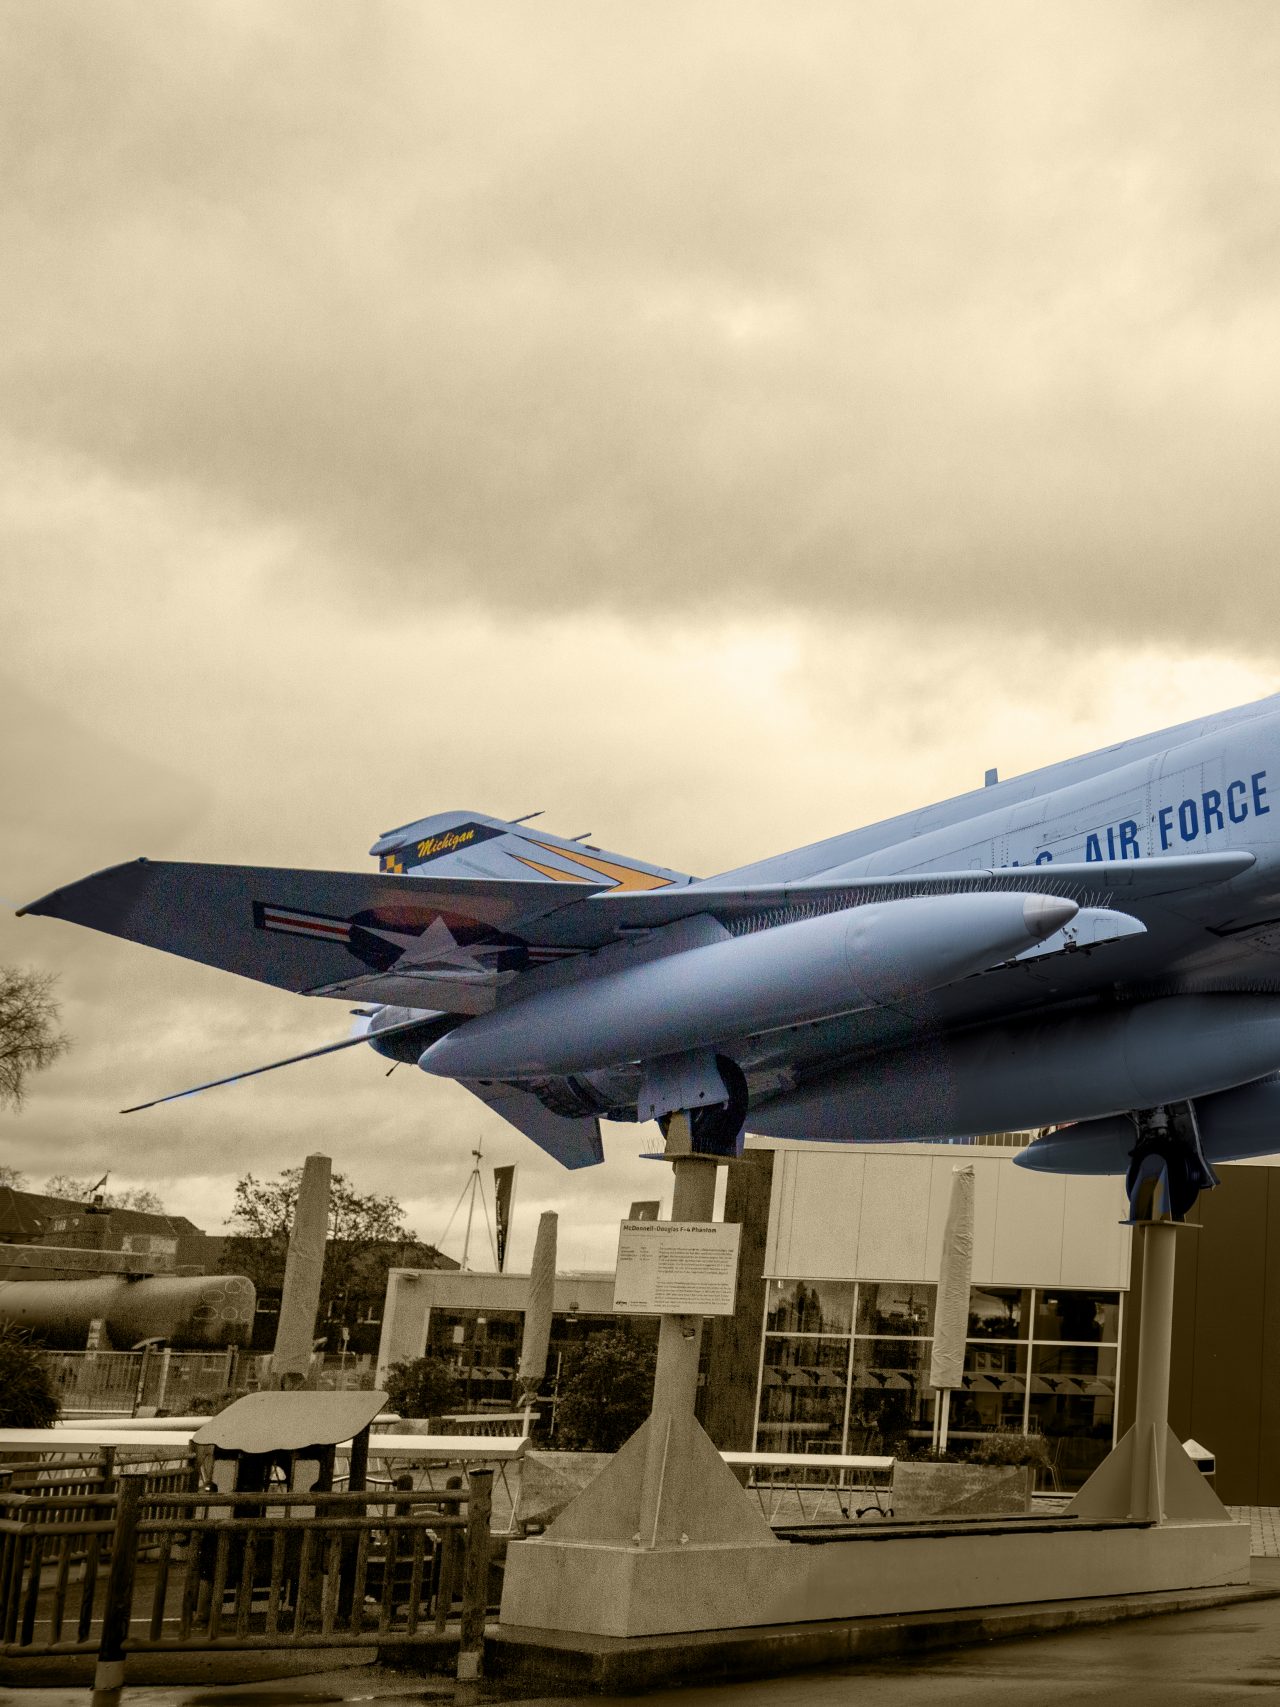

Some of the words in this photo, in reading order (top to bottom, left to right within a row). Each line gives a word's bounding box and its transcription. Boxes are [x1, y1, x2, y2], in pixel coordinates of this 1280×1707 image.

[417, 828, 474, 858] Michigan
[1086, 820, 1140, 862] AIR
[1158, 771, 1271, 850] FORCE
